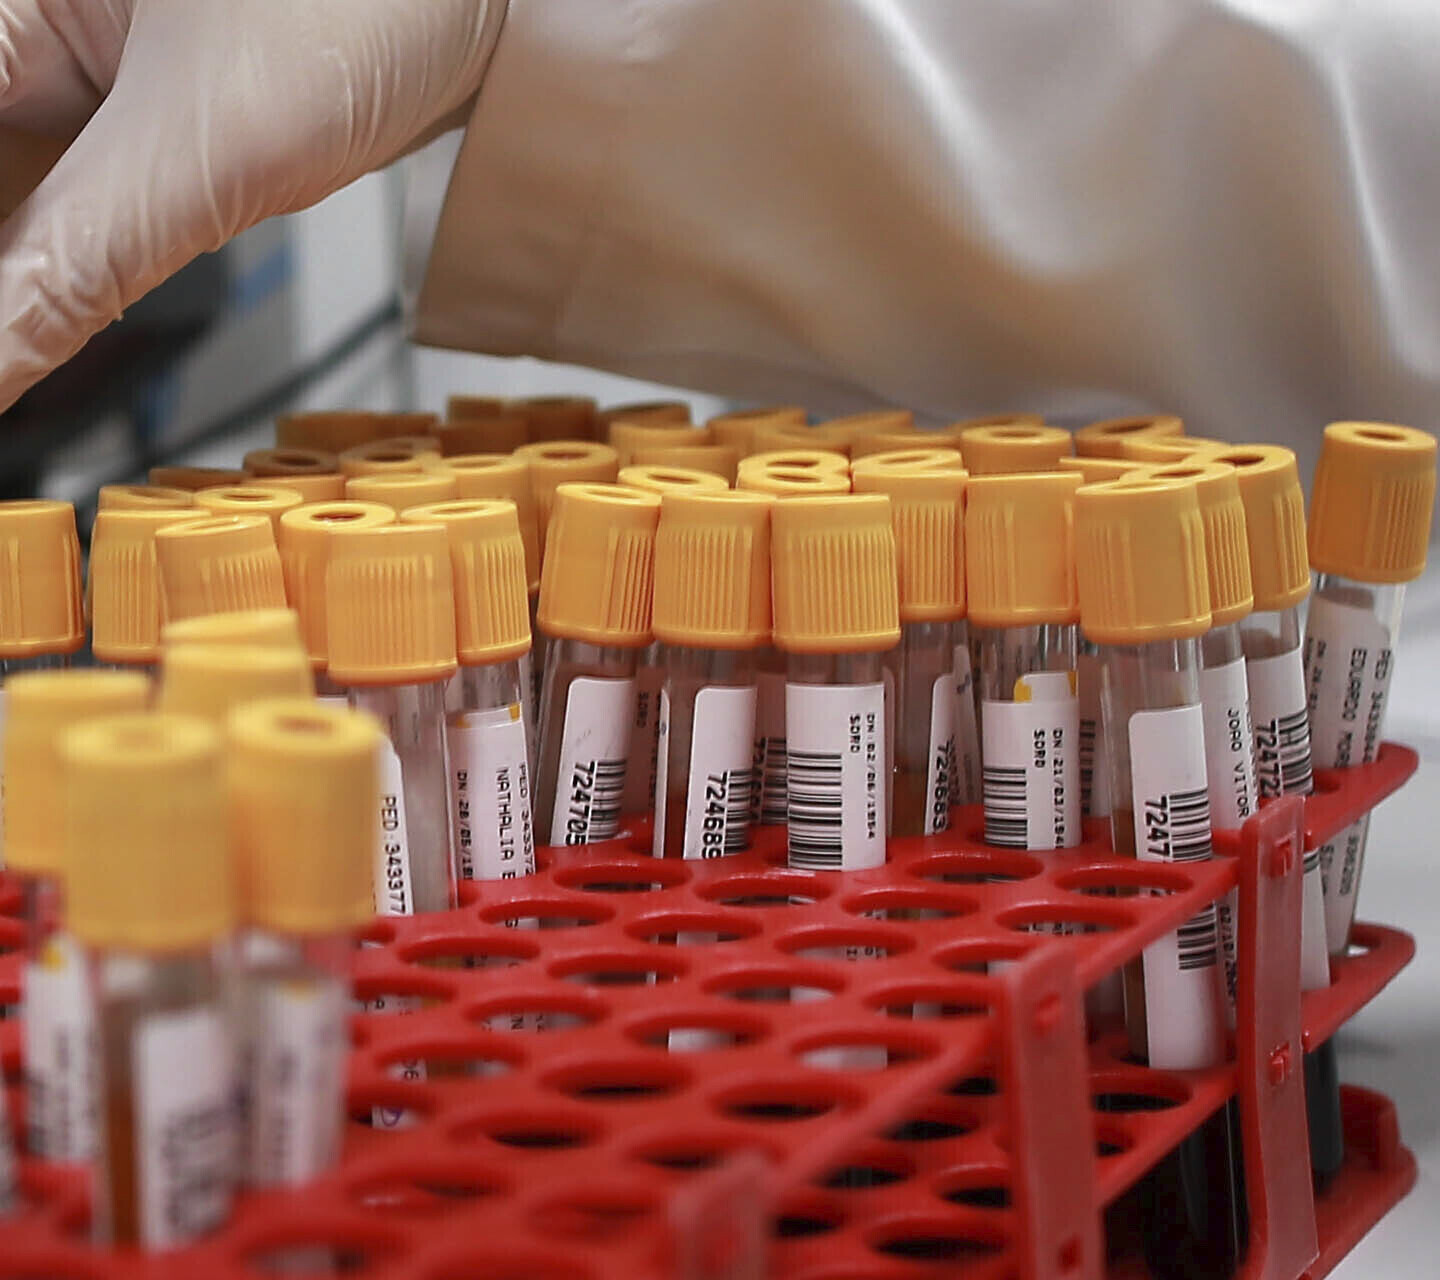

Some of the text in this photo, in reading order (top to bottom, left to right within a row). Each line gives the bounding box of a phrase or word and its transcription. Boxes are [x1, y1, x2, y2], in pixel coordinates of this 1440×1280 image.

[1342, 647, 1368, 722] EDUARDO
[849, 714, 861, 754] SORO
[1034, 729, 1047, 769] SORO
[494, 765, 516, 863] NATHALIA
[1233, 761, 1251, 819] VITOR
